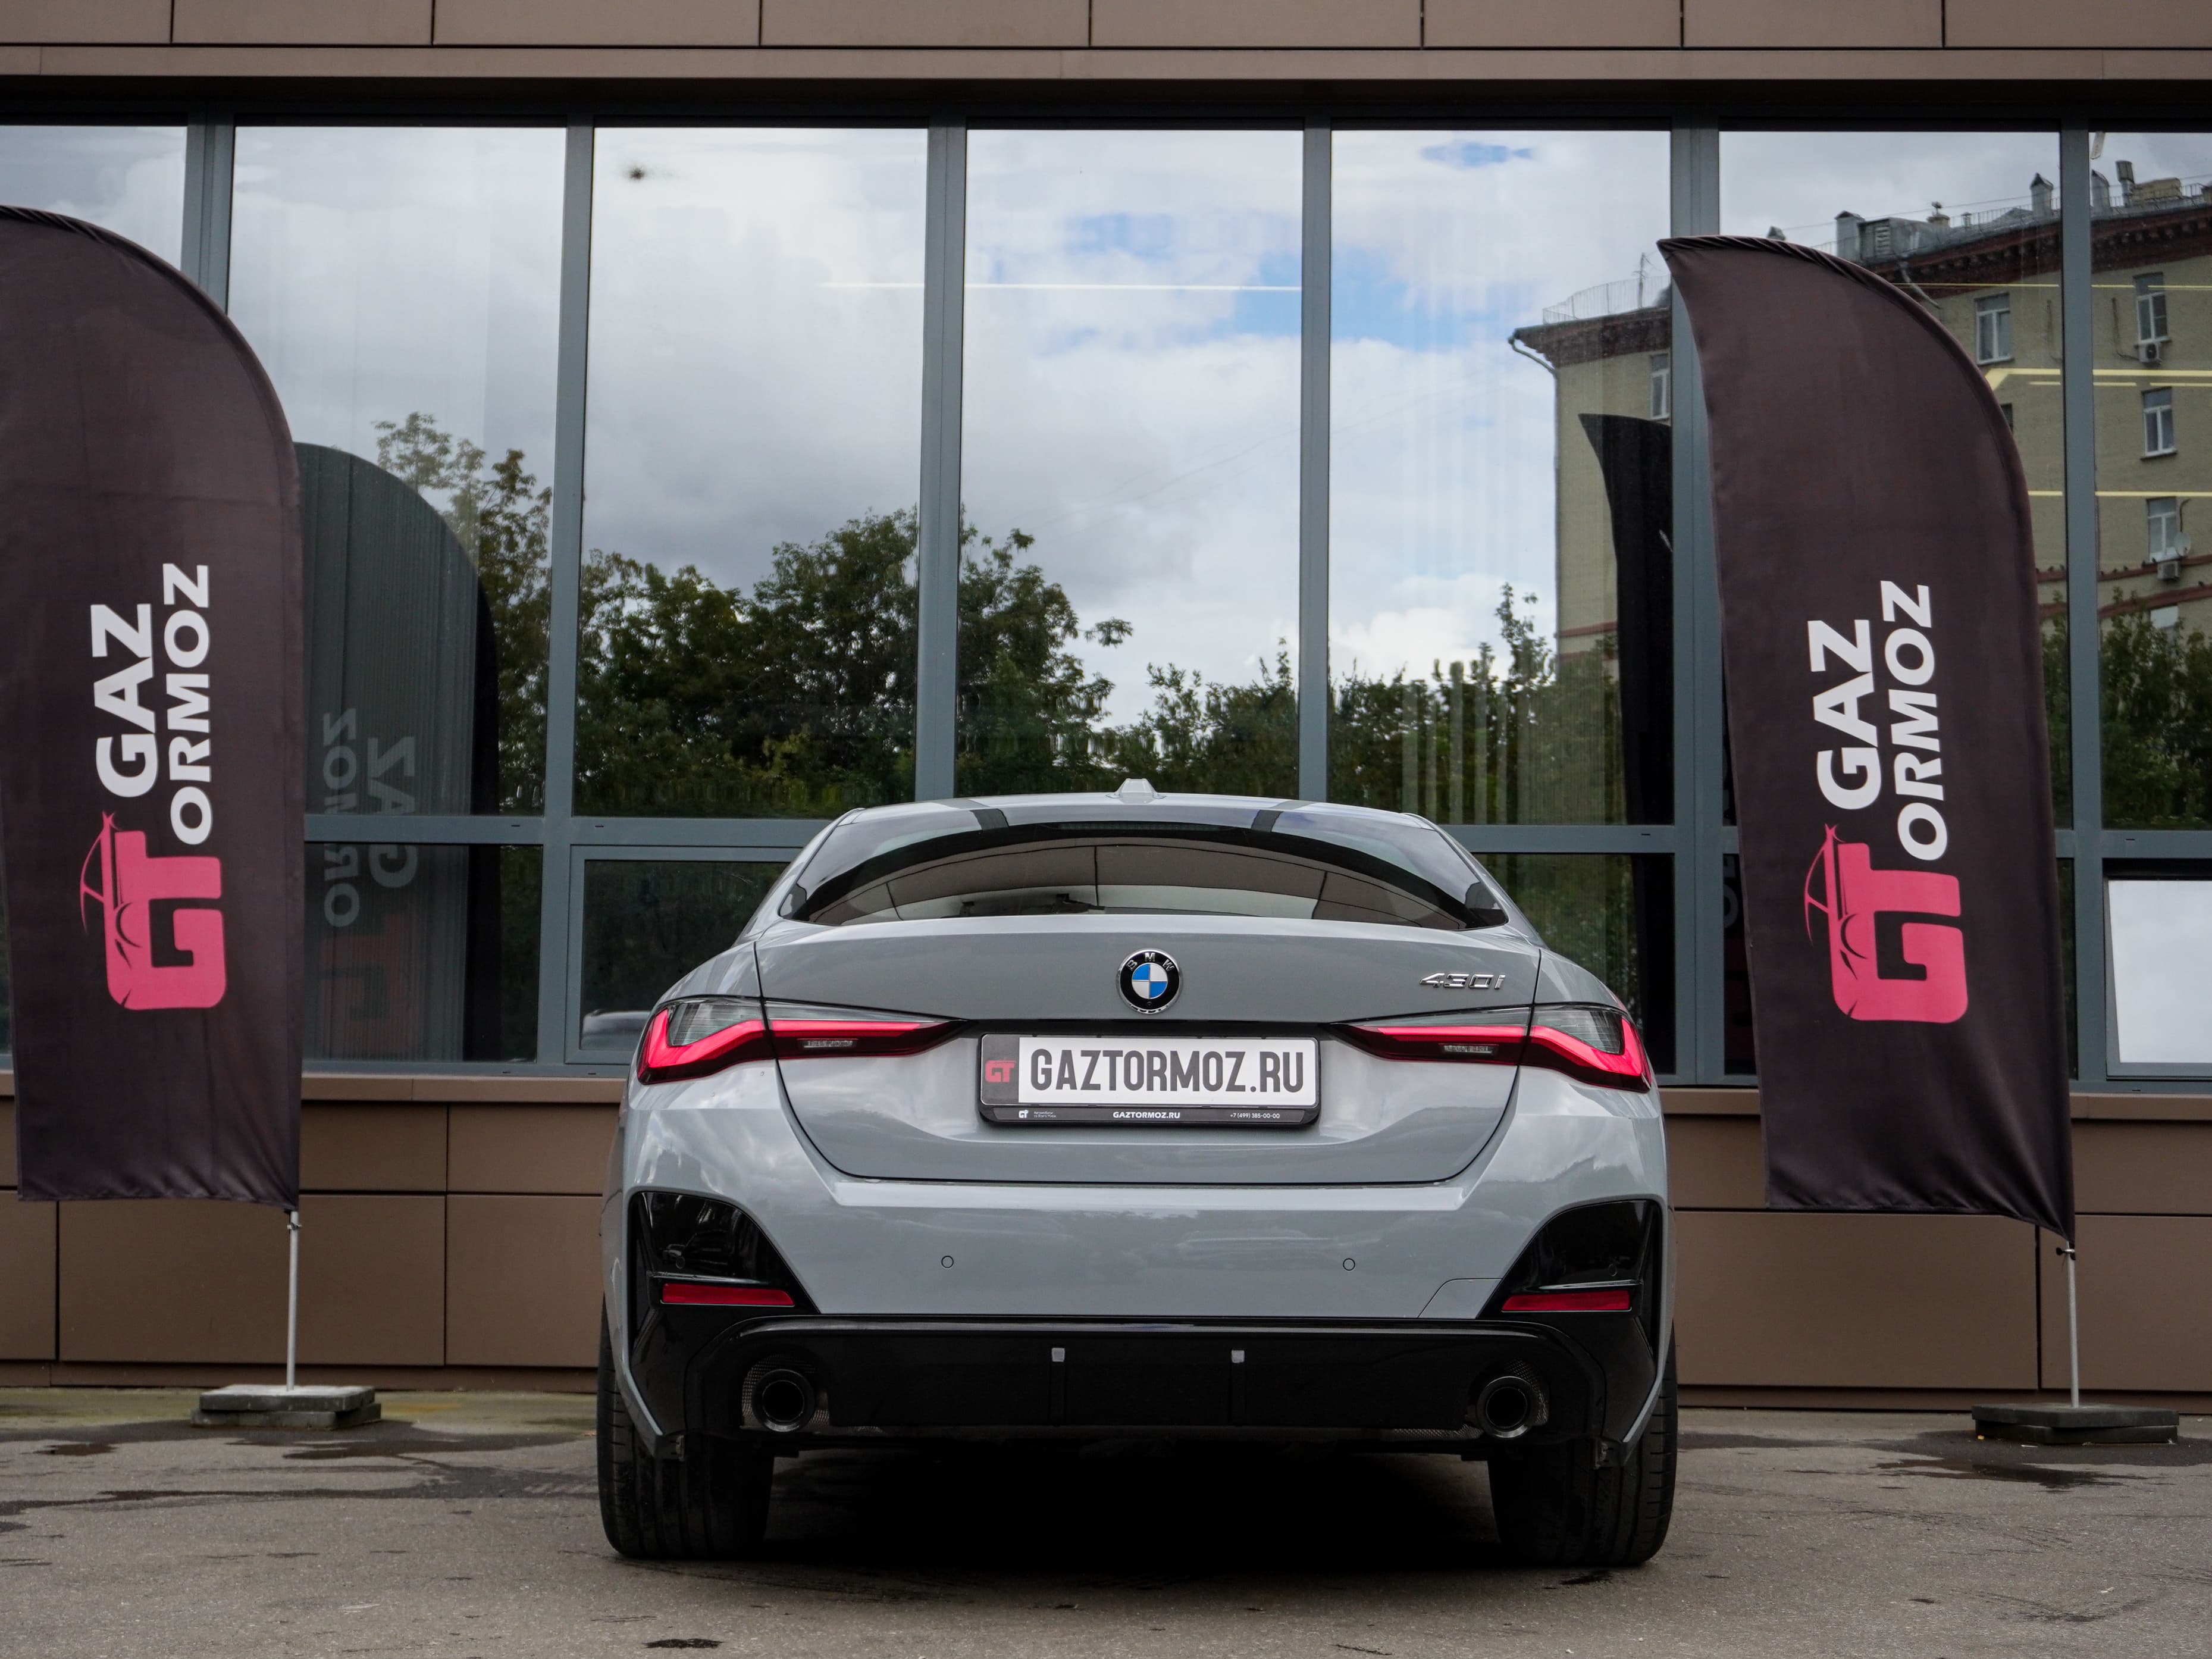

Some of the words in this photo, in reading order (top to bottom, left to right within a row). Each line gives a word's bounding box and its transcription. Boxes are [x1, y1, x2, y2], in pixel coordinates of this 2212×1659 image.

[90, 603, 158, 797] GAZ
[162, 563, 213, 844] ORMOZ
[1807, 619, 1882, 809] GAZ
[1881, 580, 1948, 861] ORMOZ
[101, 831, 227, 1010] GT
[1126, 952, 1176, 972] BMW
[1420, 972, 1506, 990] 430i
[1826, 843, 1968, 1023] GT
[985, 1060, 1015, 1083] GT
[1030, 1048, 1304, 1094] GAZTORMOZ.RU
[1113, 1111, 1181, 1119] GAZTORMOZ.RU
